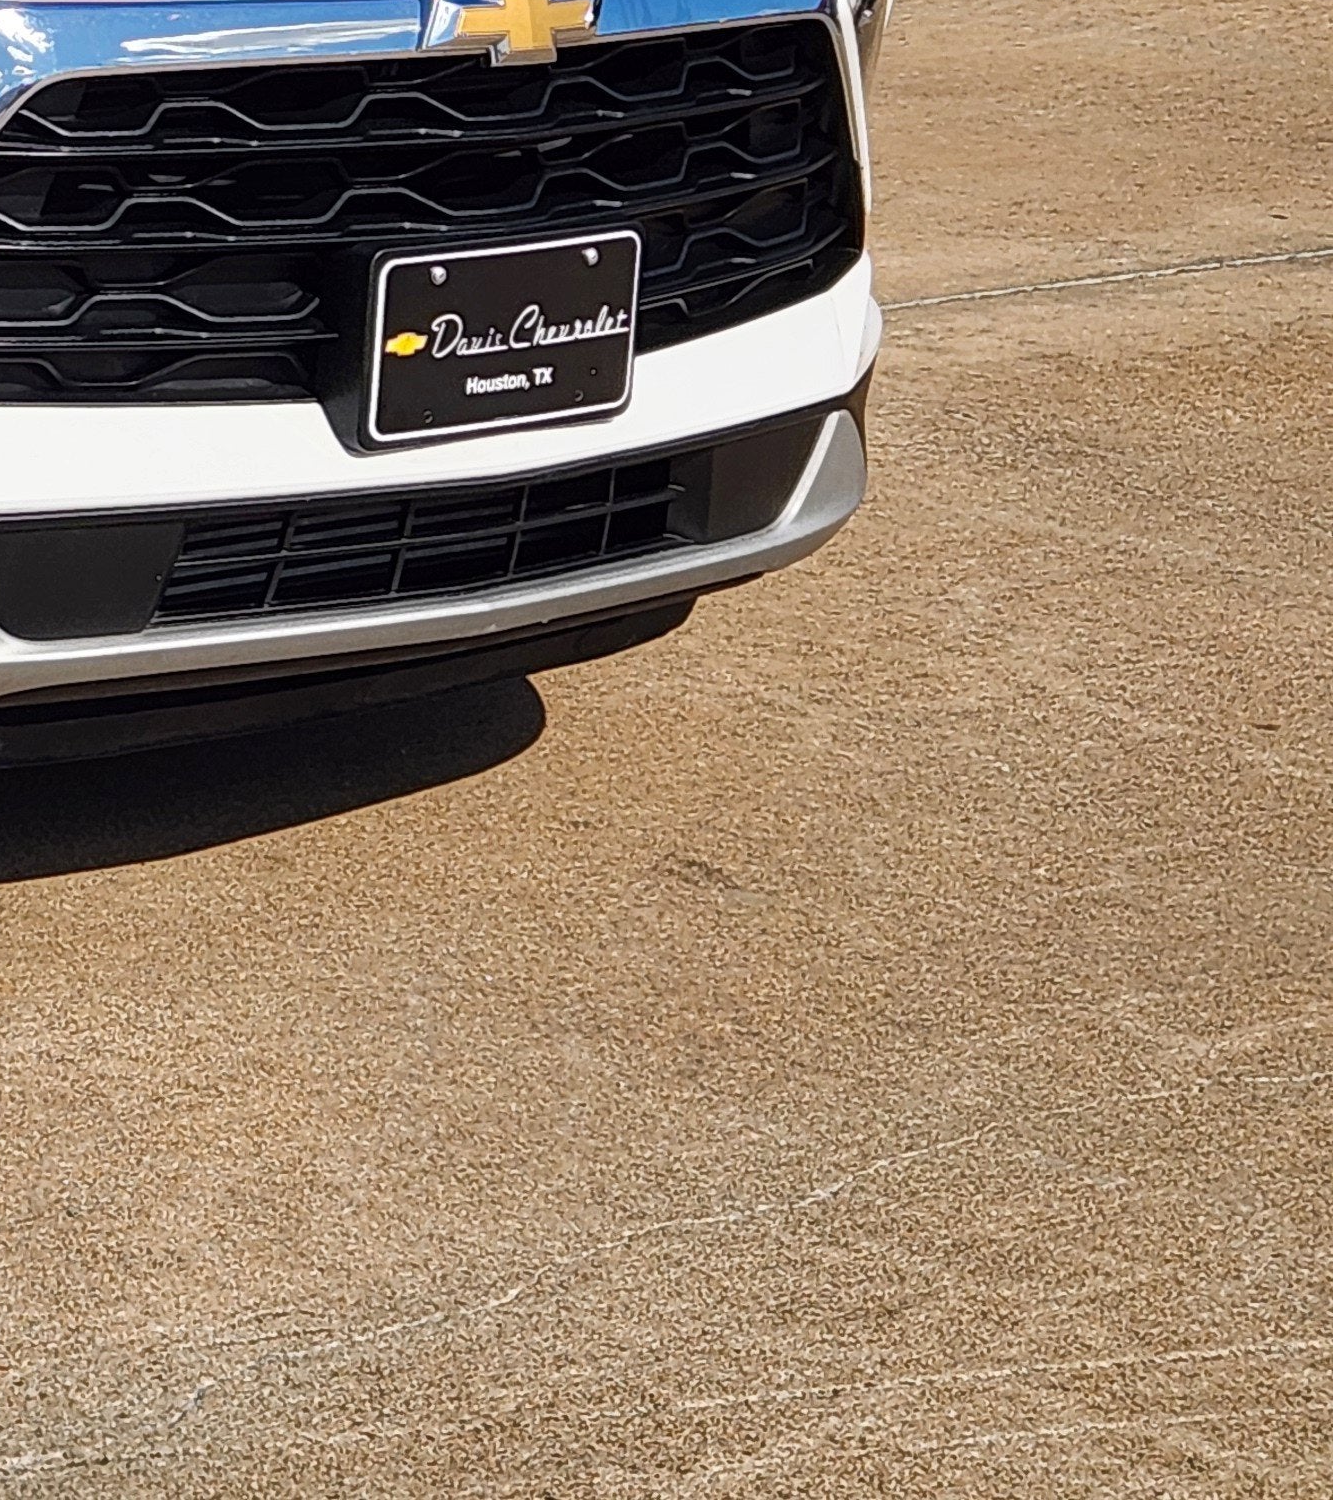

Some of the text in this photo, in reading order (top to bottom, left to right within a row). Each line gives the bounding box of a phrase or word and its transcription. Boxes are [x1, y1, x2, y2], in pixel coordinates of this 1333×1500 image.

[431, 303, 630, 359] Davis Chevrolet
[465, 367, 555, 396] Houston, TX
